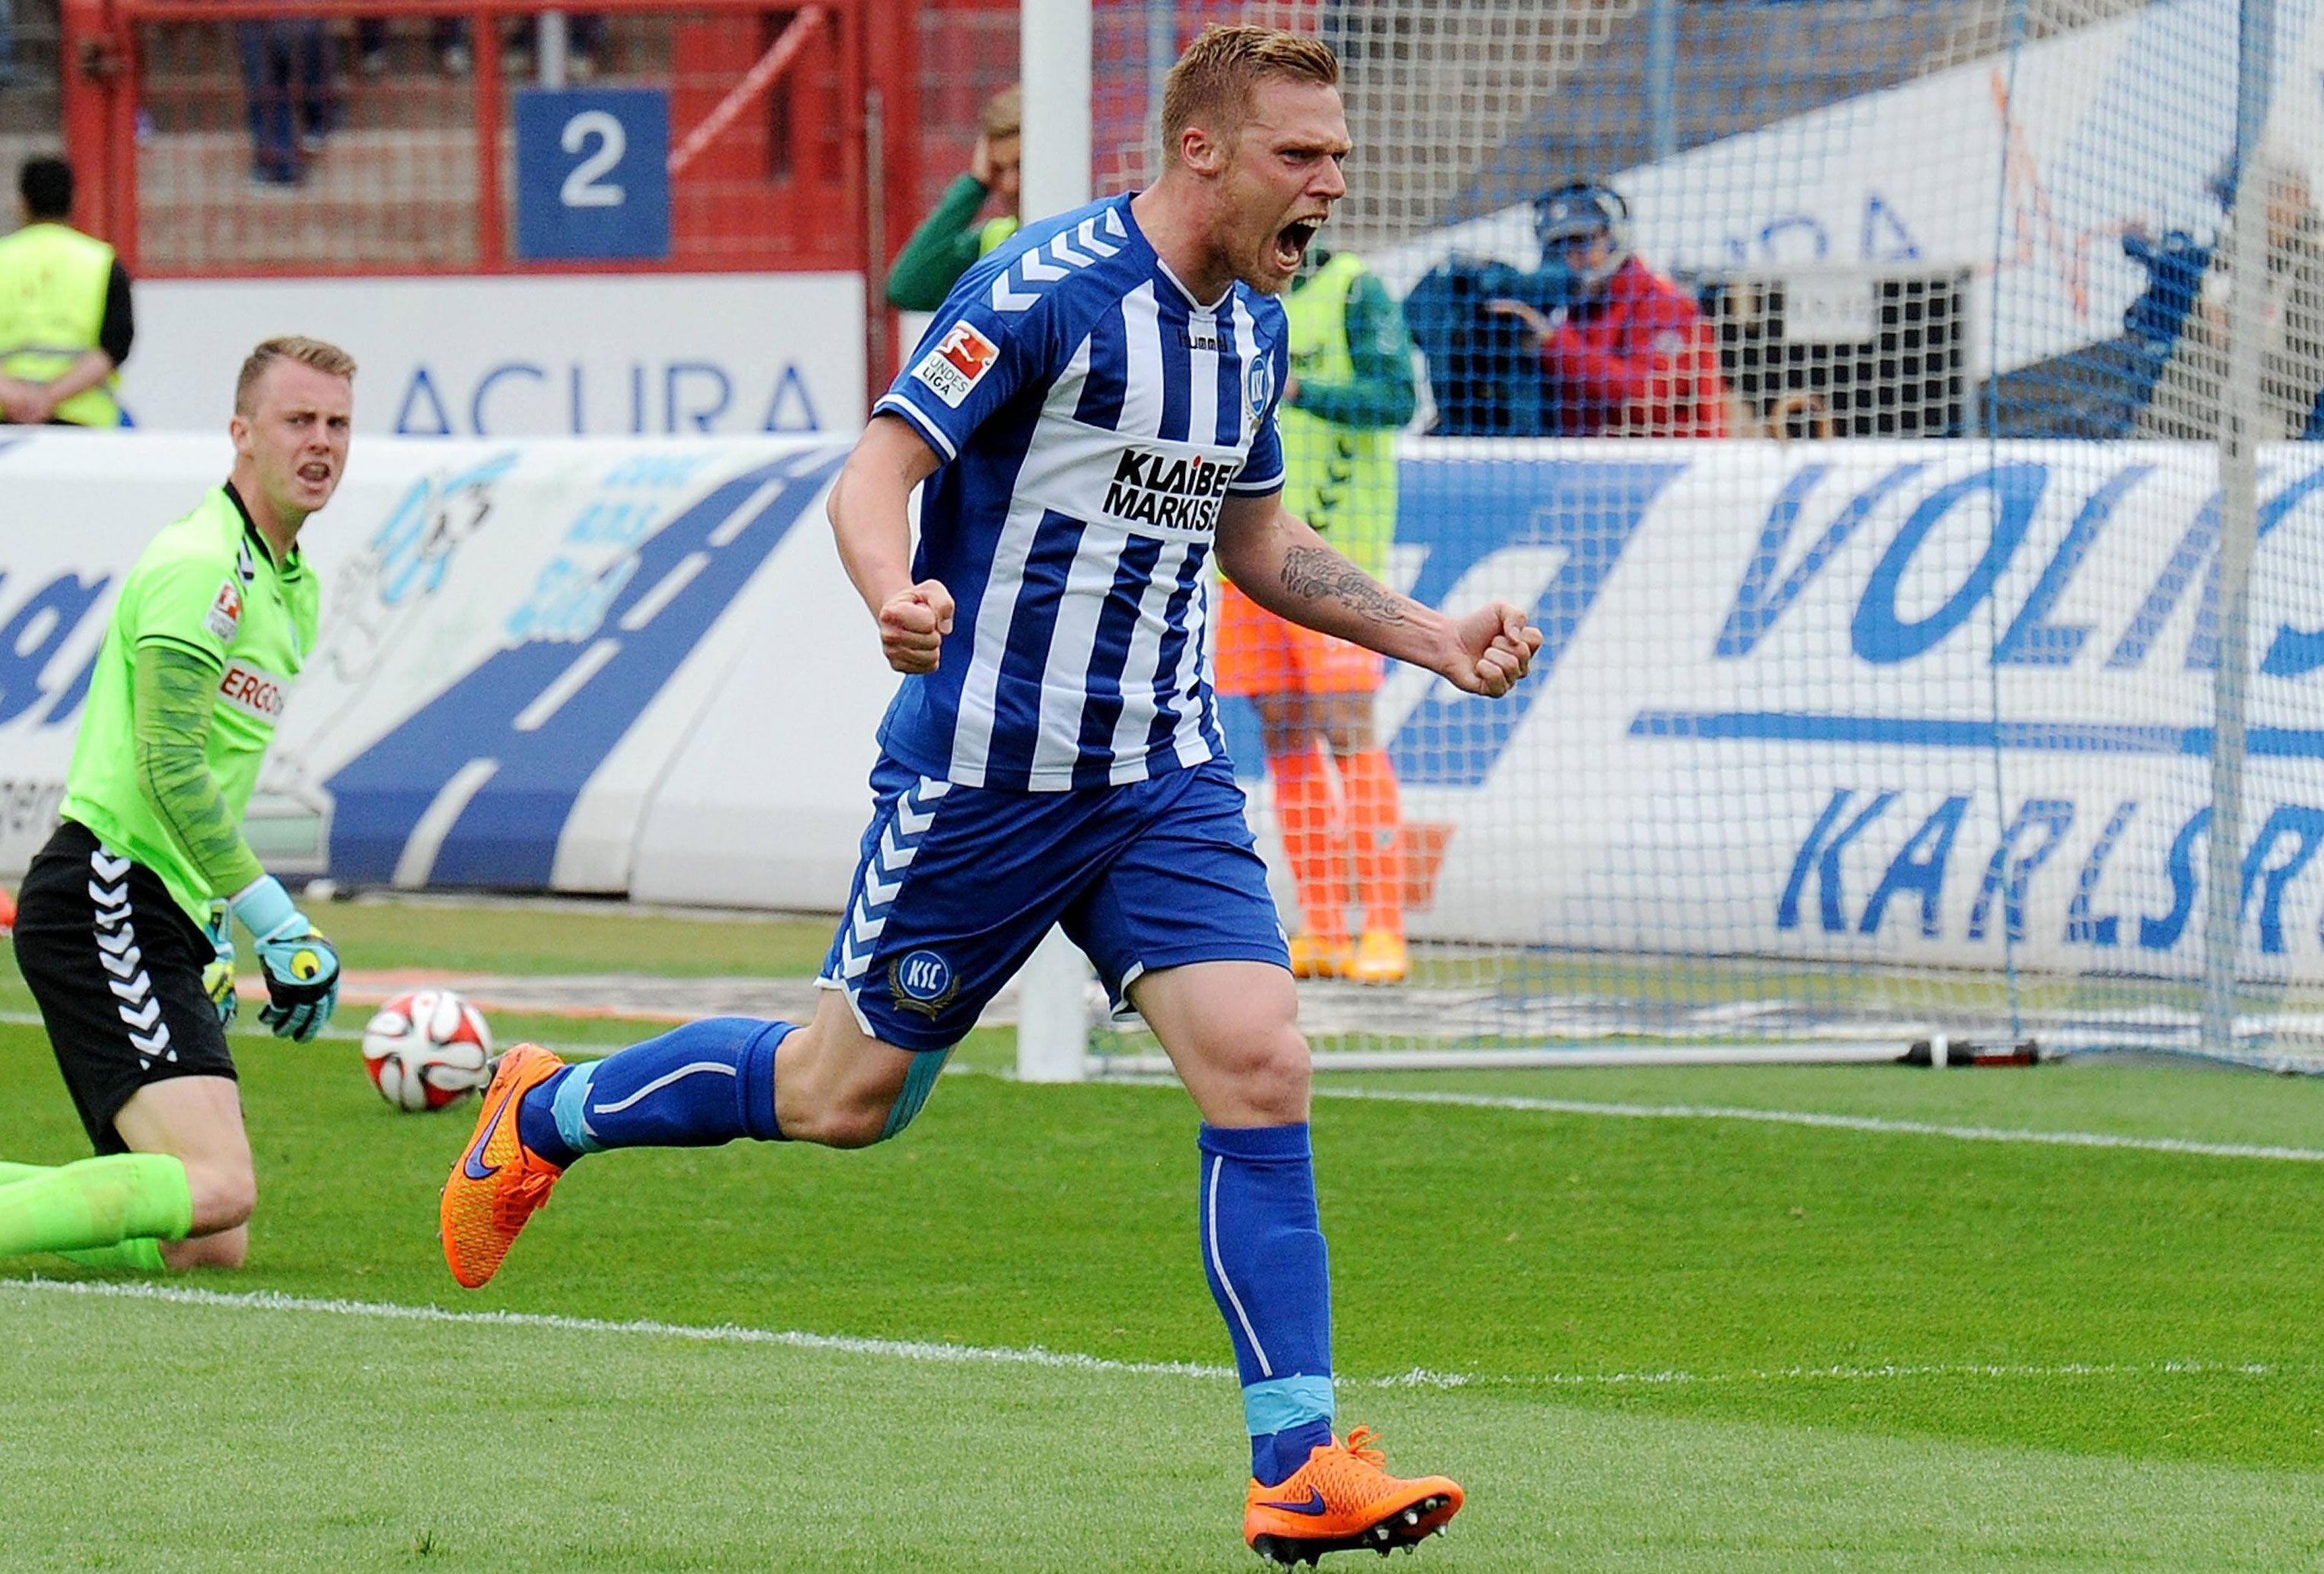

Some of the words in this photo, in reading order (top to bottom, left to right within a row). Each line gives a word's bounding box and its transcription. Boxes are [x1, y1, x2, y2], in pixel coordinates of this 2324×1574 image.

[562, 110, 625, 206] 2
[393, 364, 820, 435] ACURA
[922, 367, 950, 396] LIGA
[929, 357, 968, 393] UNDES
[1777, 788, 2324, 955] KARLSR
[907, 959, 941, 990] KSC
